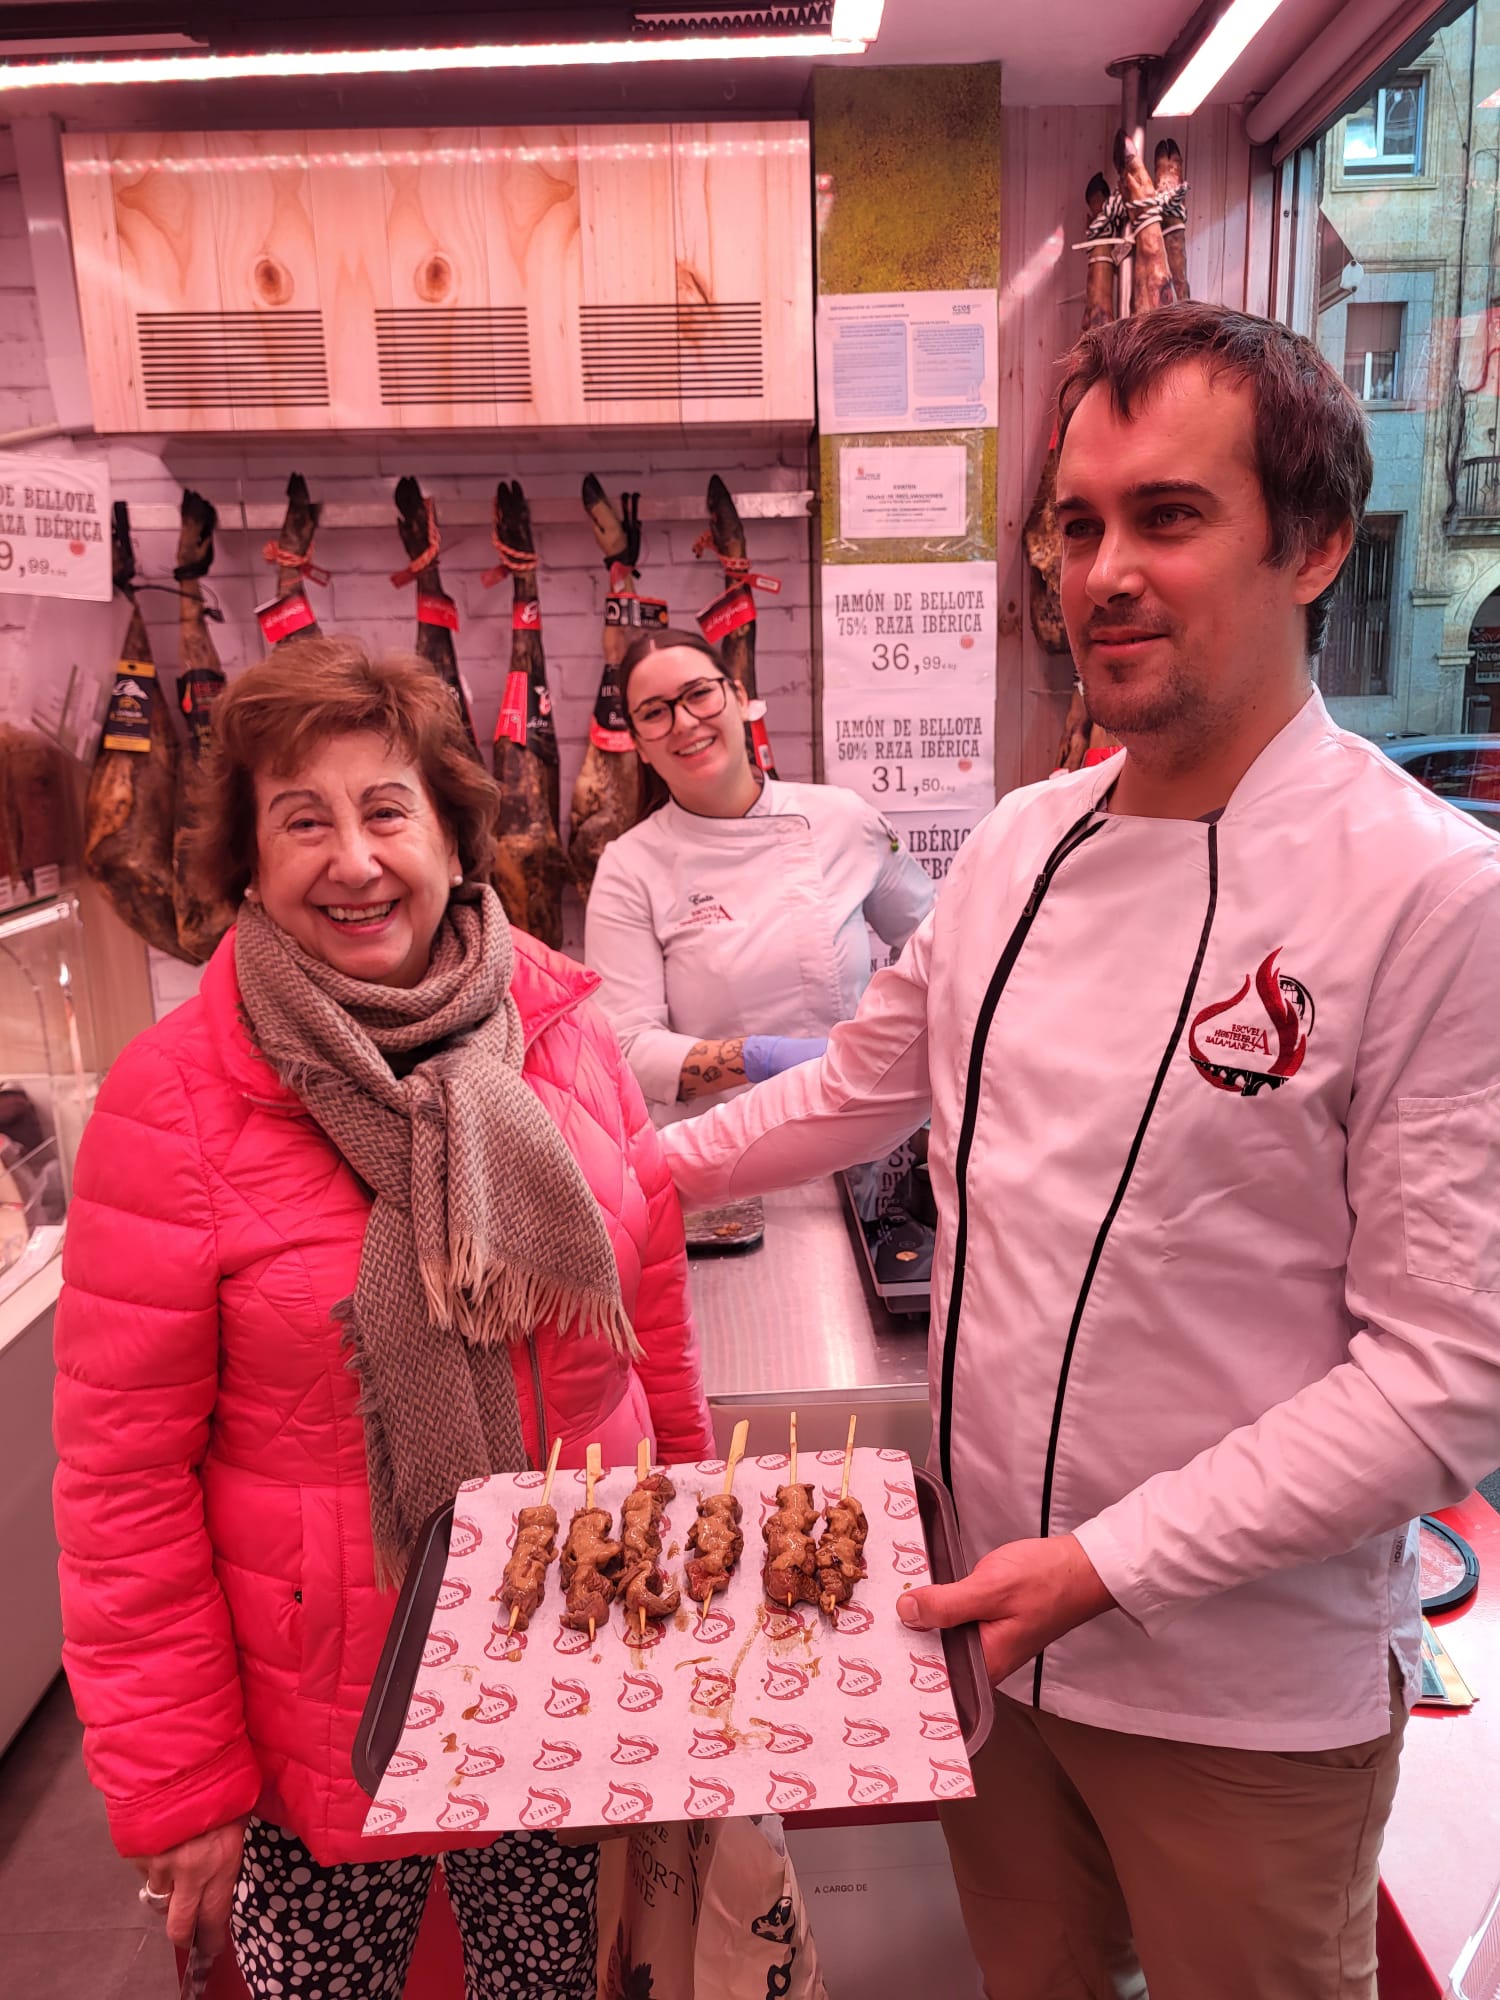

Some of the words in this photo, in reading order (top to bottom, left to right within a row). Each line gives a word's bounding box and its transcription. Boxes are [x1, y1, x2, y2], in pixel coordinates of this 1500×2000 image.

[24, 487, 96, 514] BELLOTA
[36, 515, 103, 542] IBÉRICA
[835, 590, 885, 616] JAMÓN
[894, 592, 912, 611] DE
[921, 590, 984, 611] BELLOTA
[838, 616, 867, 636] 75%
[876, 615, 914, 635] RAZA
[923, 611, 983, 634] IBÉRICA
[836, 716, 884, 742] JAMÓN
[894, 718, 911, 737] DE
[920, 717, 983, 738] BELLOTA
[838, 742, 867, 760] 50%
[876, 741, 913, 760] RAZA
[921, 737, 980, 759] IBÉRICA
[908, 824, 971, 853] IBÉRIC
[636, 1843, 685, 1897] ORT
[814, 1886, 821, 1895] A
[822, 1884, 855, 1894] CARGO
[856, 1883, 869, 1892] DE
